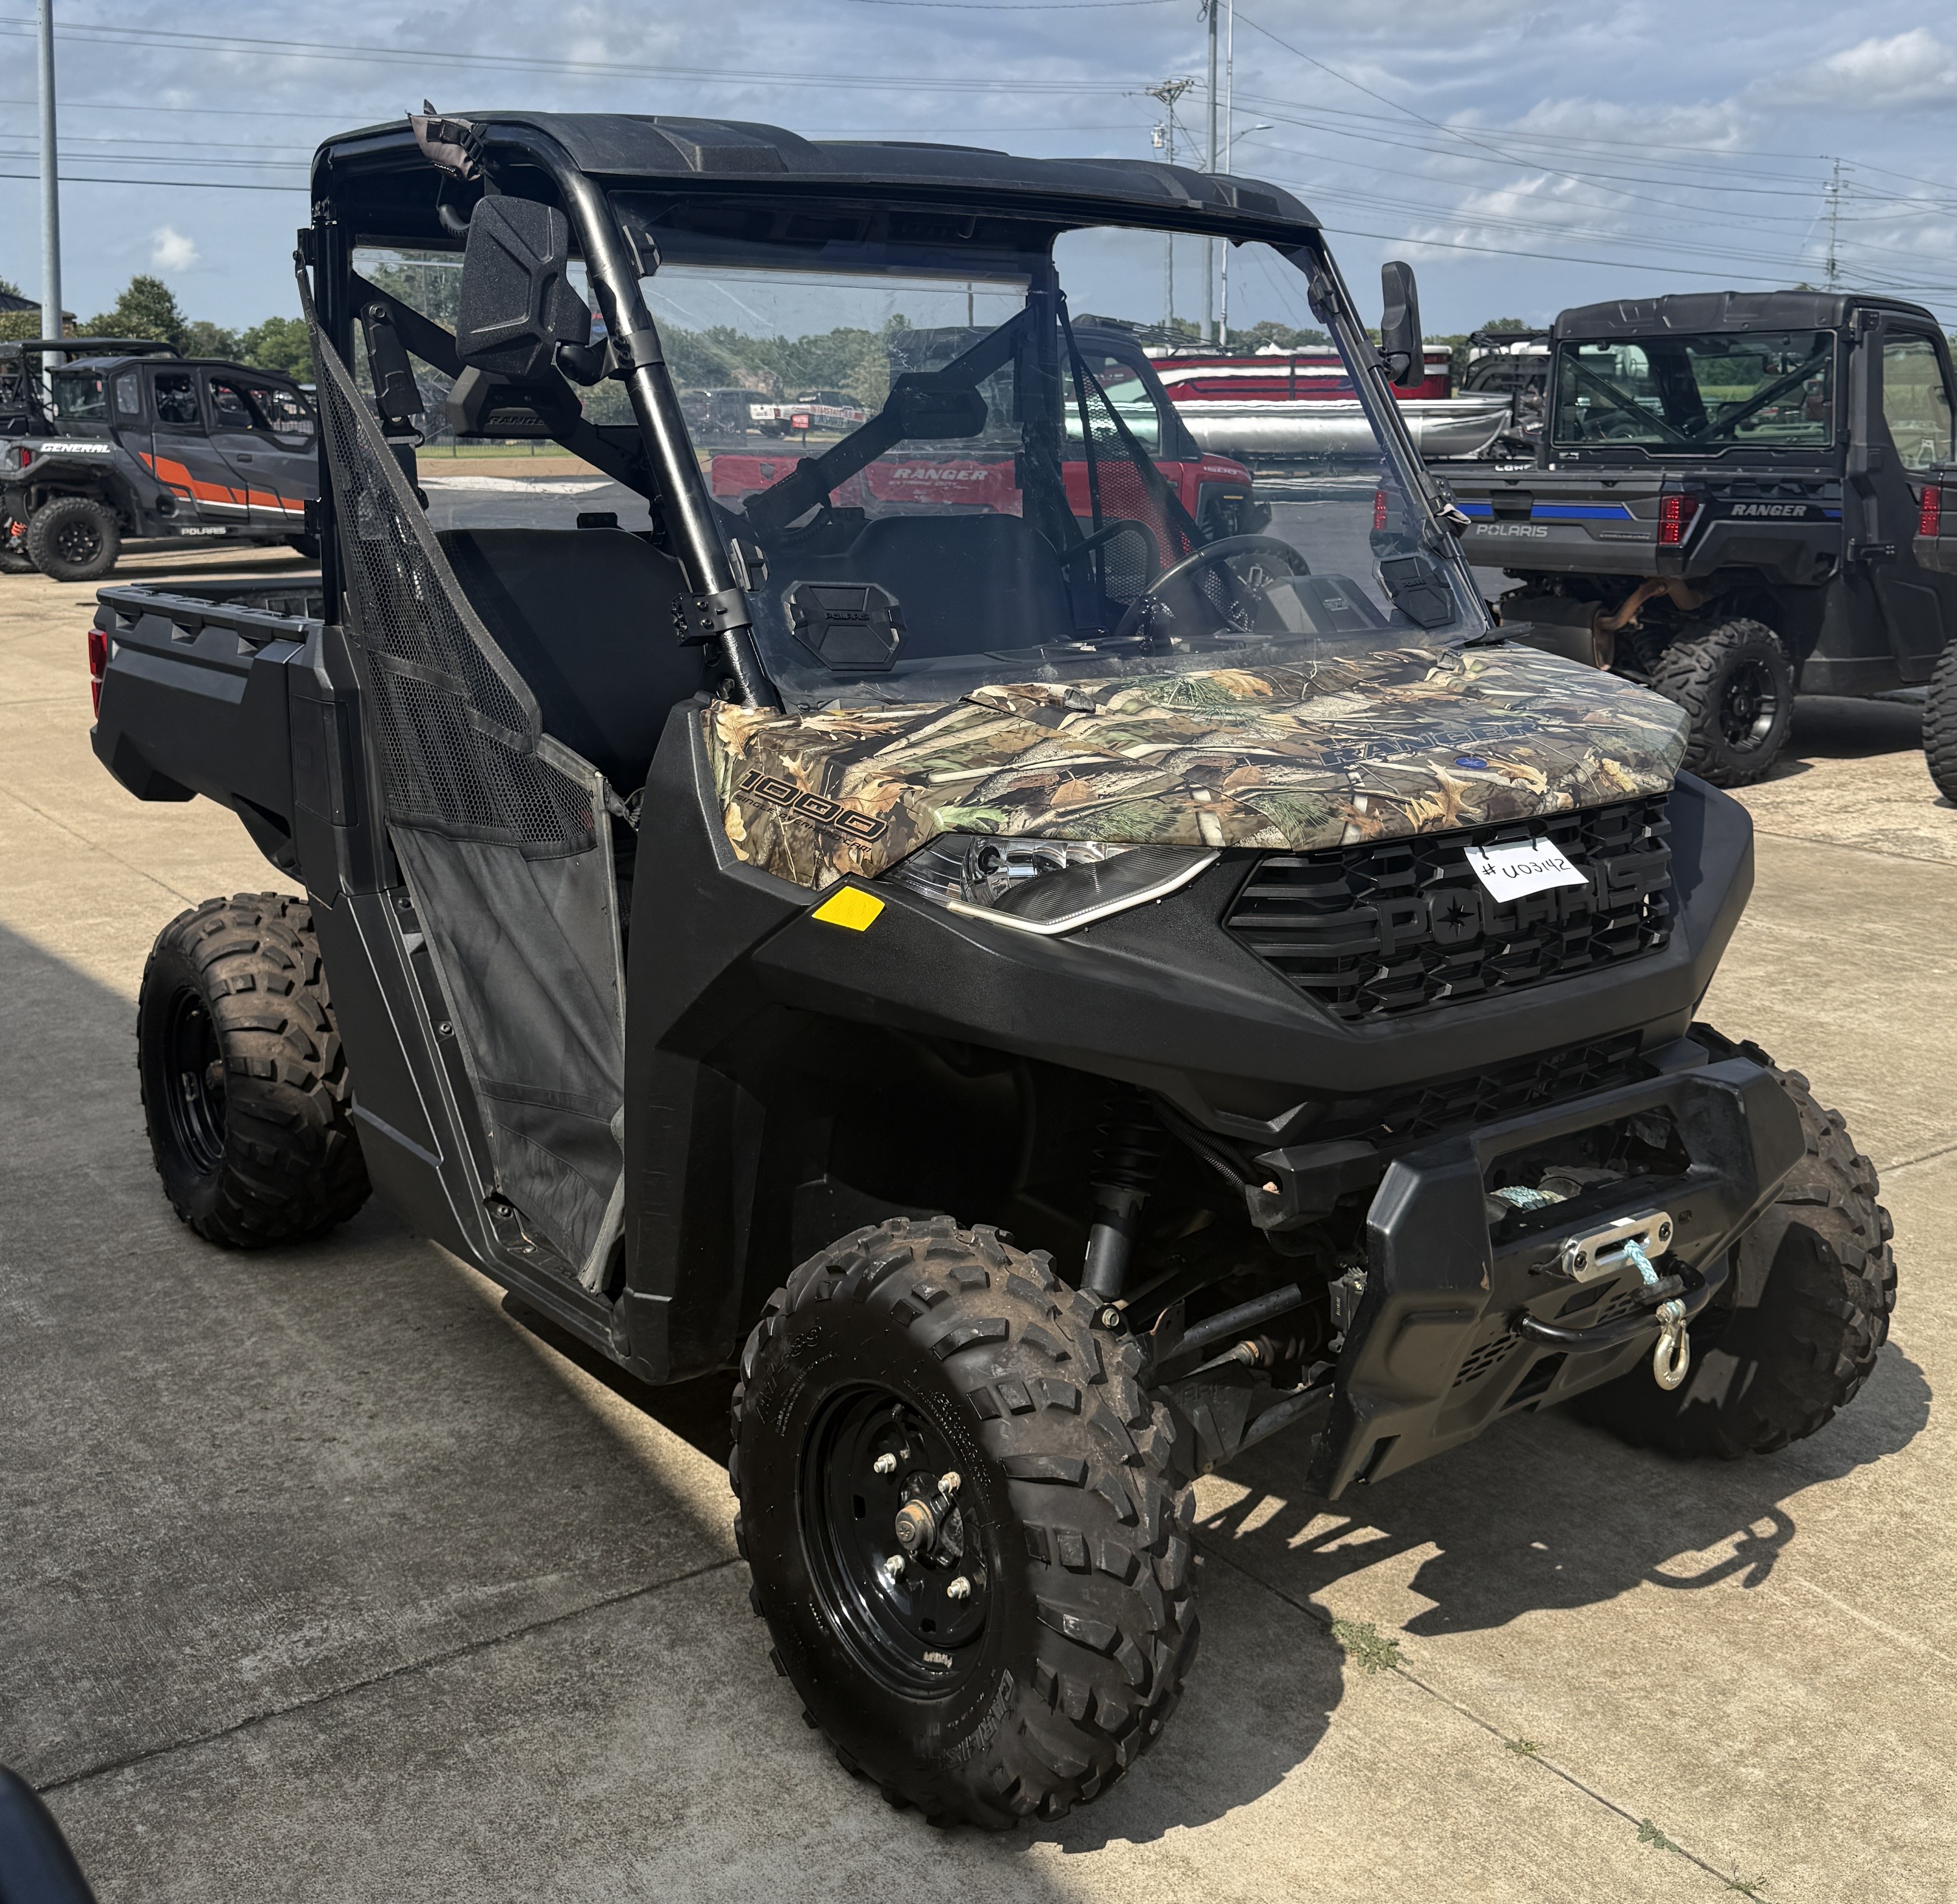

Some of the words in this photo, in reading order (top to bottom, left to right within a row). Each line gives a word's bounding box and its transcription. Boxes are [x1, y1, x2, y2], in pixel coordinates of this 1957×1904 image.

[490, 416, 545, 426] RANGE
[40, 443, 110, 453] GENERAL
[893, 468, 988, 480] RANGER
[1731, 504, 1807, 516] RANGER
[181, 526, 226, 535] POLARIS
[1476, 524, 1548, 538] POLARIS
[1316, 722, 1543, 767] RANGER
[739, 768, 888, 845] 1000
[735, 794, 778, 815] SINGLE
[778, 812, 842, 841] OVERHEAD
[843, 839, 872, 853] CAM
[1378, 857, 1647, 957] POLARIS
